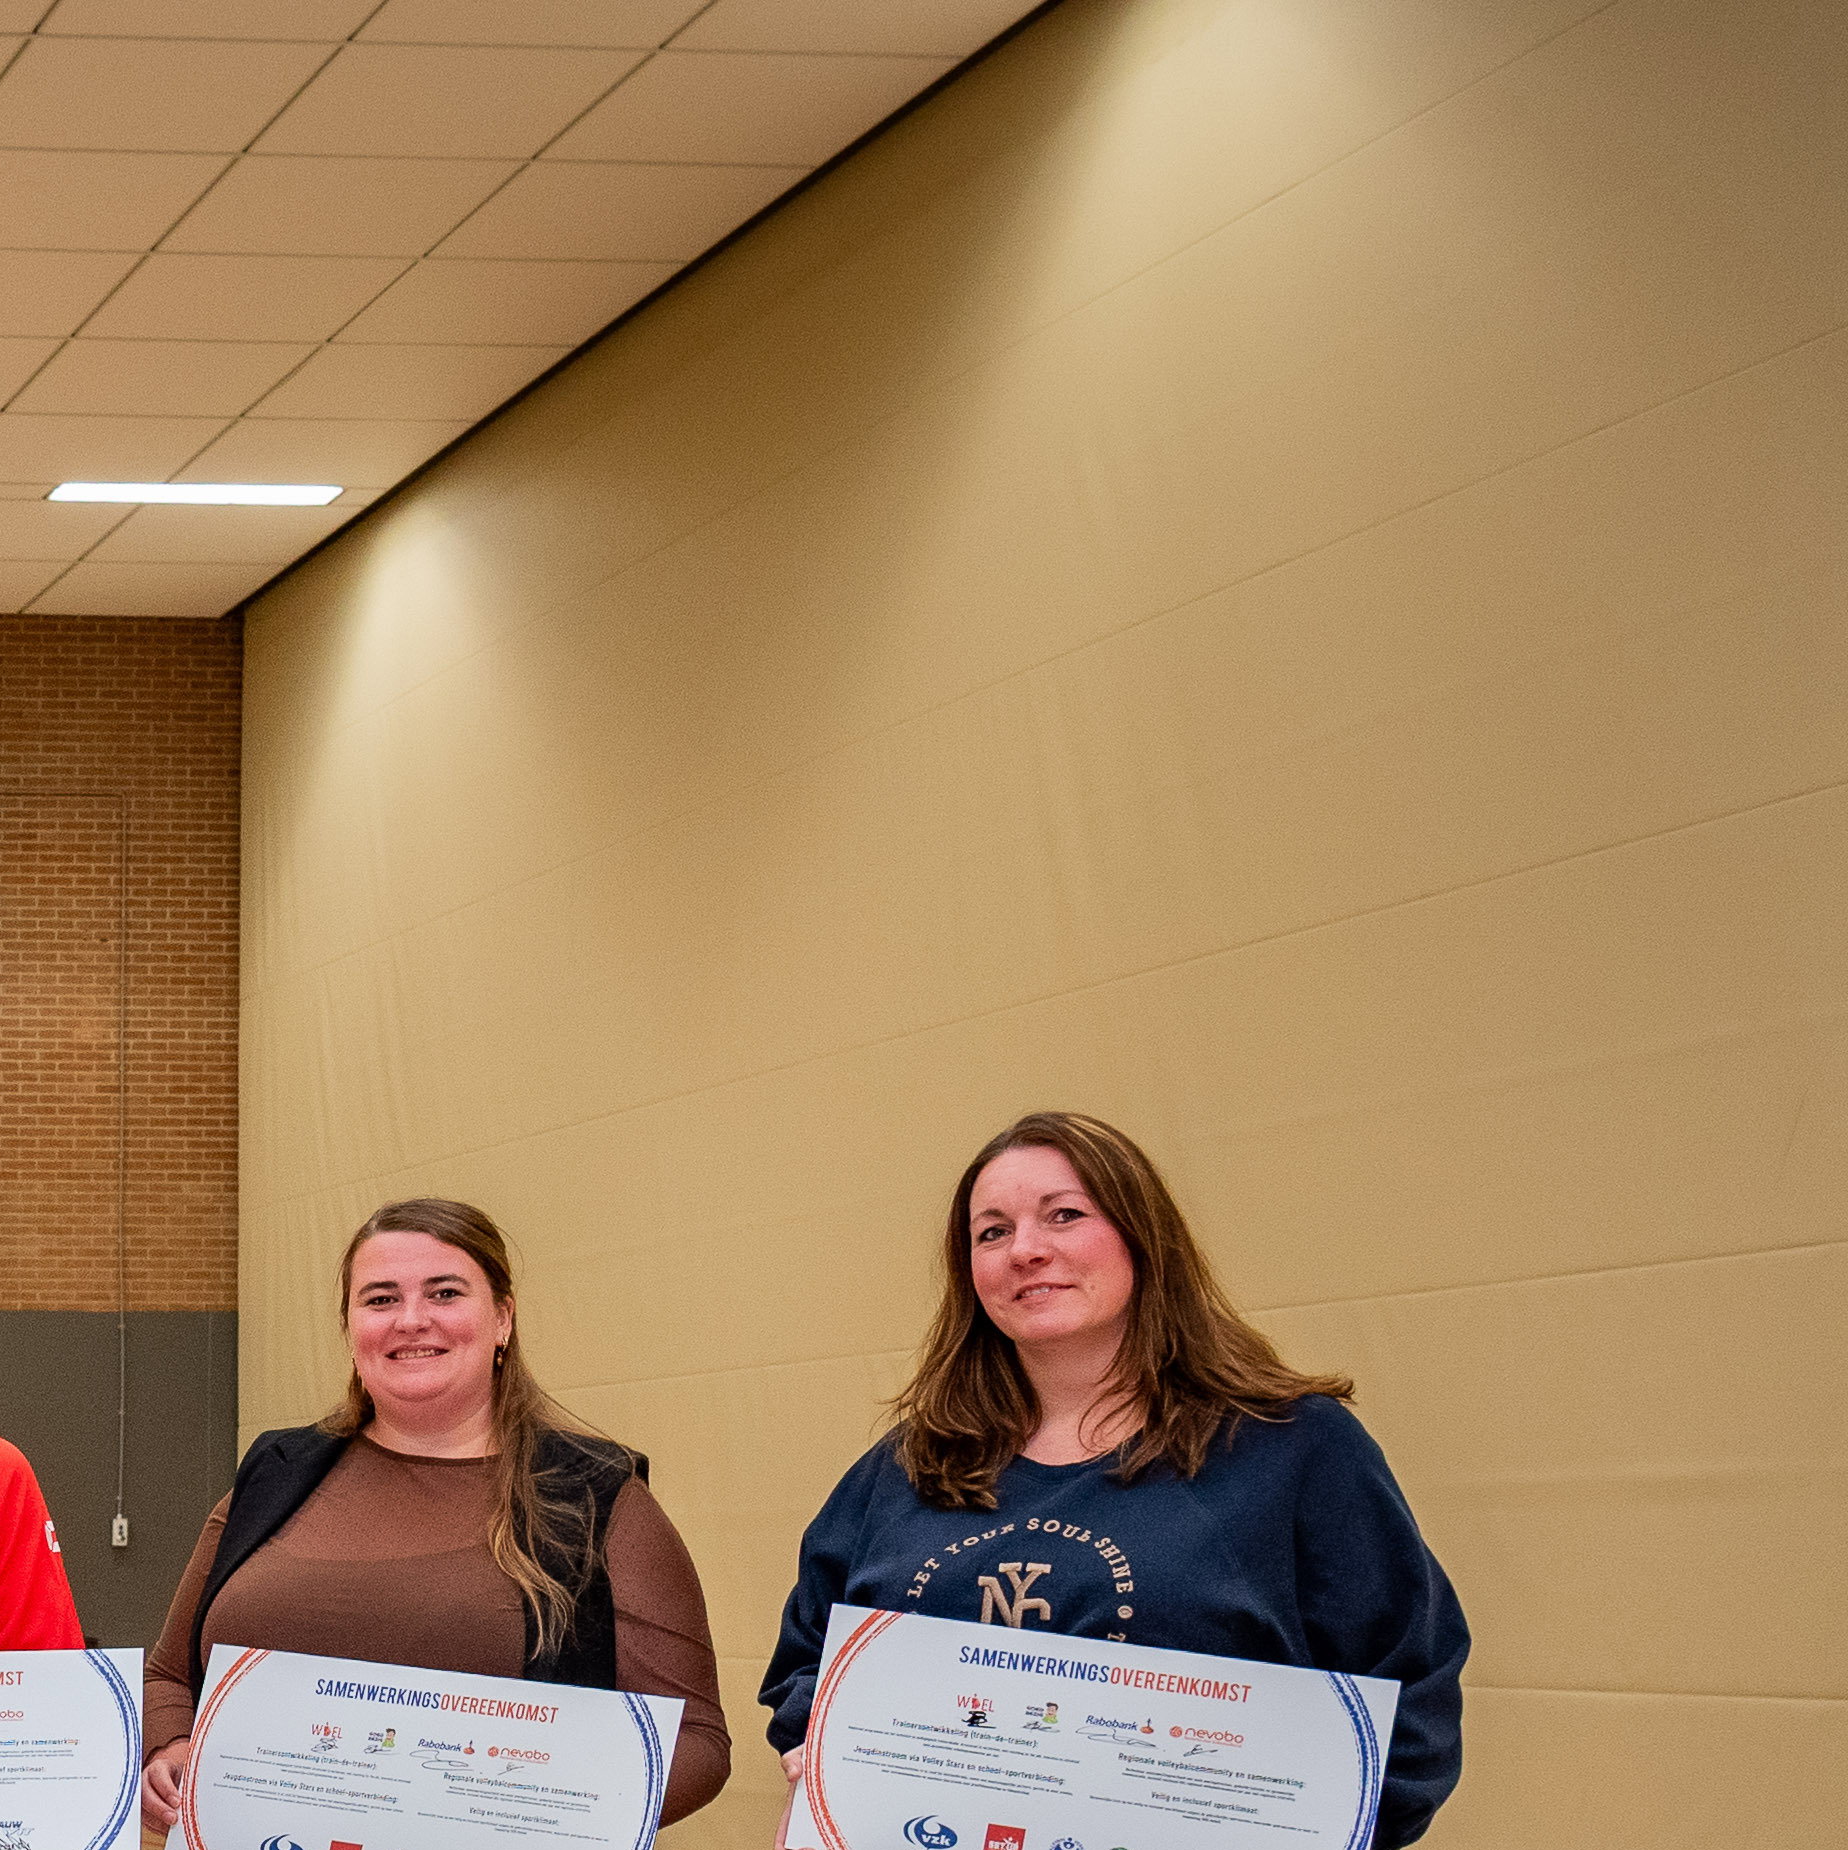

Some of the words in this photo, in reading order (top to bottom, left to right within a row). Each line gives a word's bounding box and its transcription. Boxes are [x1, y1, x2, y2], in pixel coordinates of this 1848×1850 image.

[907, 1558, 940, 1599] LET
[944, 1523, 1015, 1555] YOUR
[1026, 1518, 1092, 1543] SOUL
[1094, 1537, 1134, 1594] SHINE
[958, 1645, 1252, 1704] SAMENWERKINGSOVEREENKOMST
[315, 1678, 559, 1724] SAMENWERKINGSOVEREENKOMST
[1085, 1714, 1138, 1731] Rabobank
[1184, 1725, 1245, 1744] nevobo
[417, 1737, 462, 1752] Rabobank
[500, 1745, 551, 1761] nevobo
[920, 1831, 951, 1847] vzk
